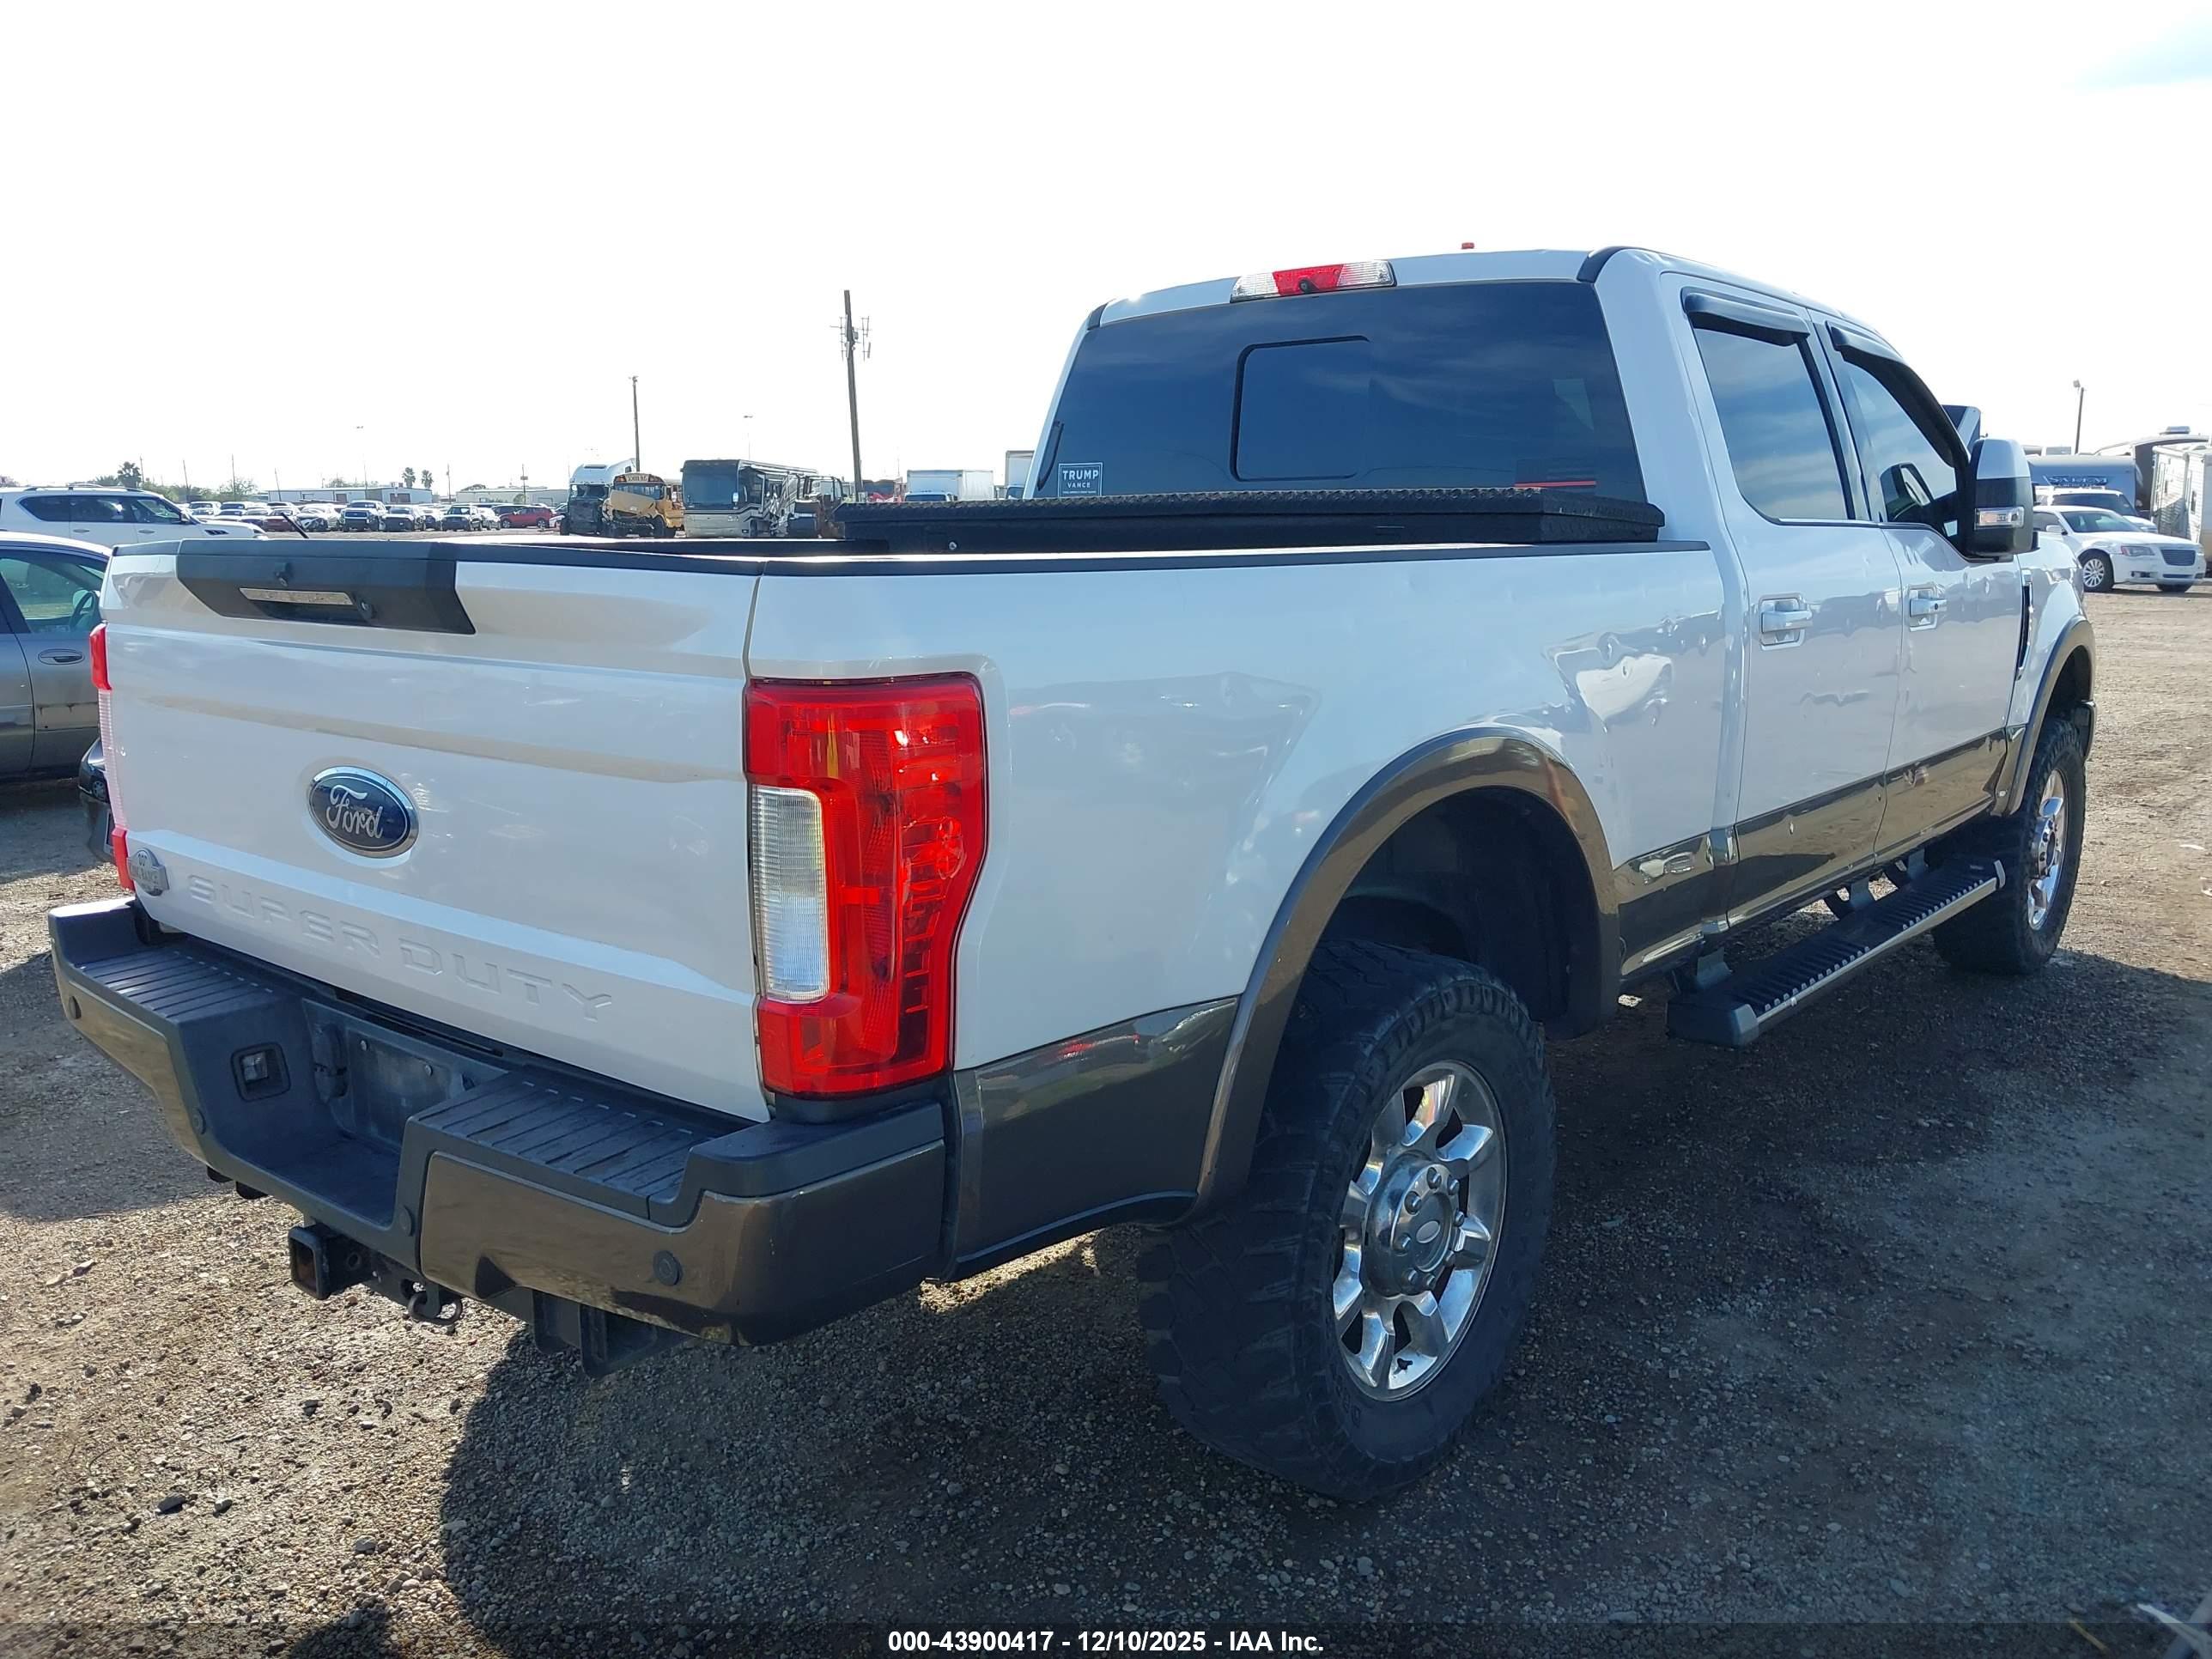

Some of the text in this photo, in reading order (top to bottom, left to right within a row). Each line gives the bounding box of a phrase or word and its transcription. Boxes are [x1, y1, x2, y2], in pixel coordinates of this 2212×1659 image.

[1062, 470, 1099, 480] TRUMP
[326, 784, 384, 838] Ford
[186, 873, 612, 1023] SUPER DUTY
